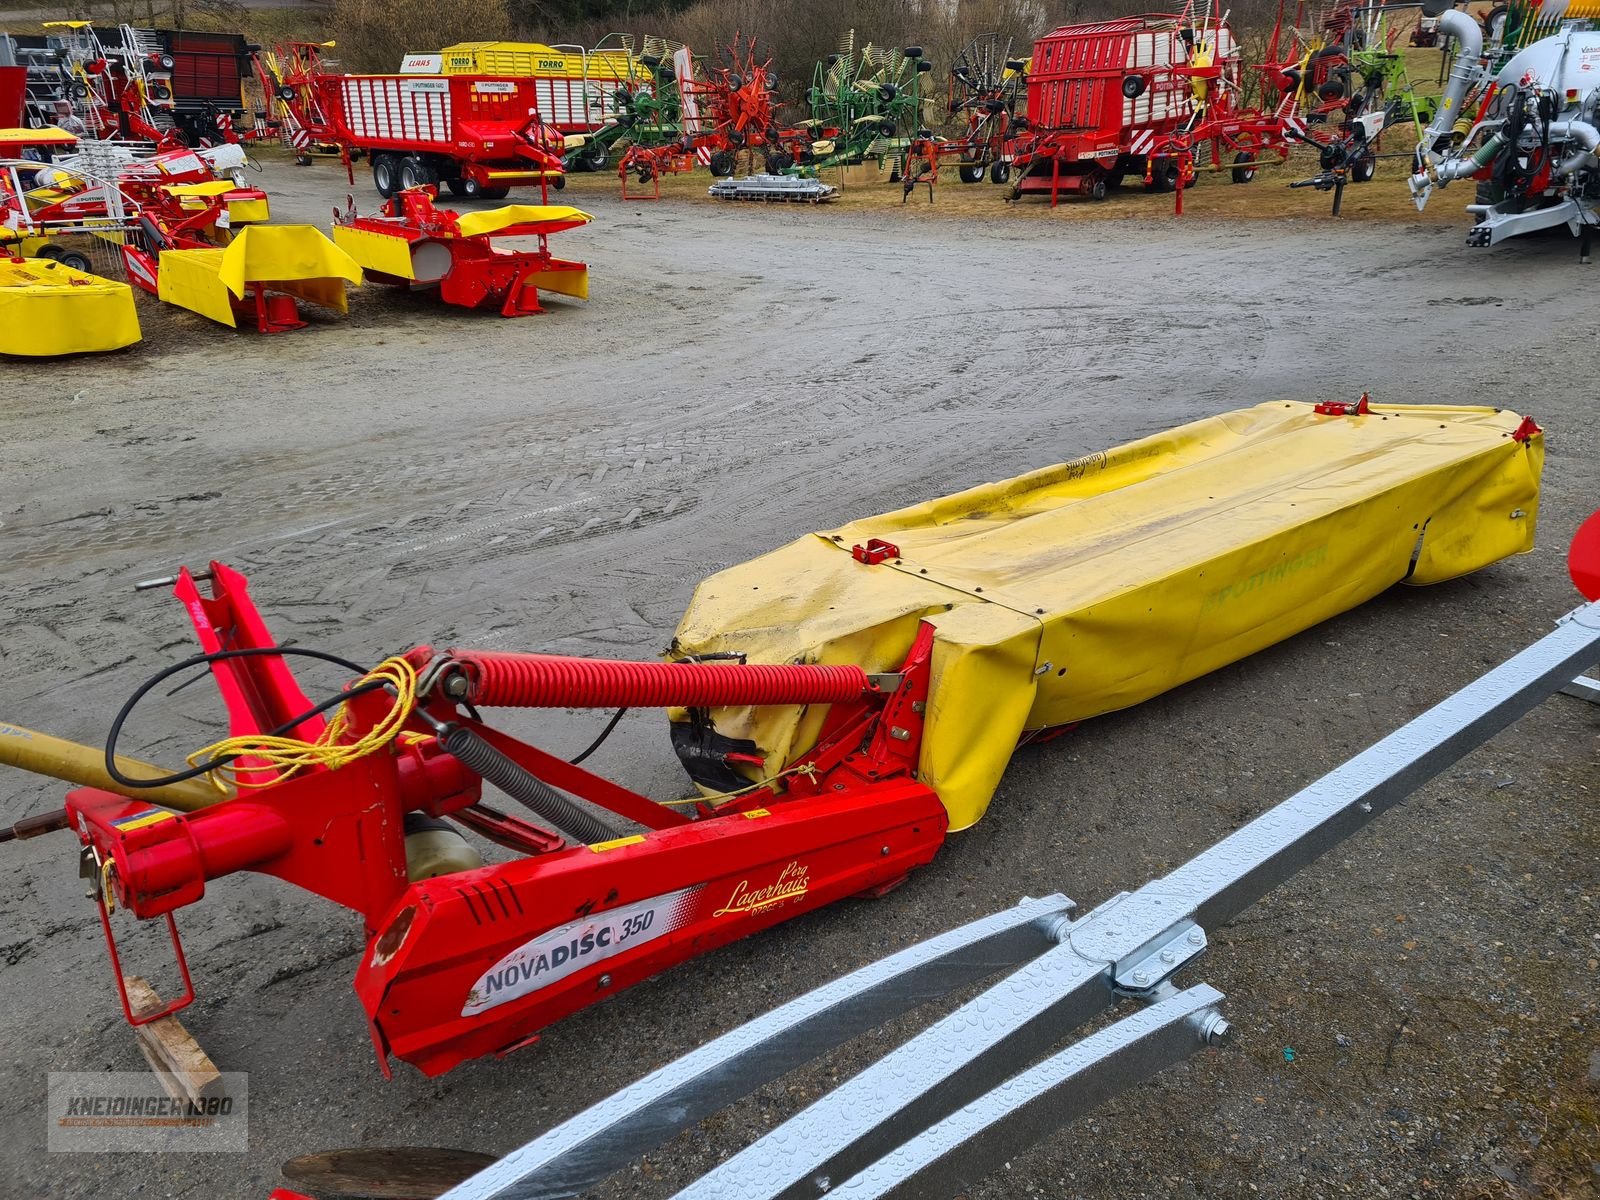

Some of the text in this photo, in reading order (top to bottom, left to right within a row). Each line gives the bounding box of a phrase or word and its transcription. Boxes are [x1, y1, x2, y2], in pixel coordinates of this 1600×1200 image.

[408, 59, 431, 67] CLAAS
[451, 58, 470, 66] TORRO
[538, 60, 564, 69] TORRO
[783, 860, 809, 879] Perg
[713, 875, 810, 917] Lagerhaus
[485, 909, 656, 995] NOVADISC 350
